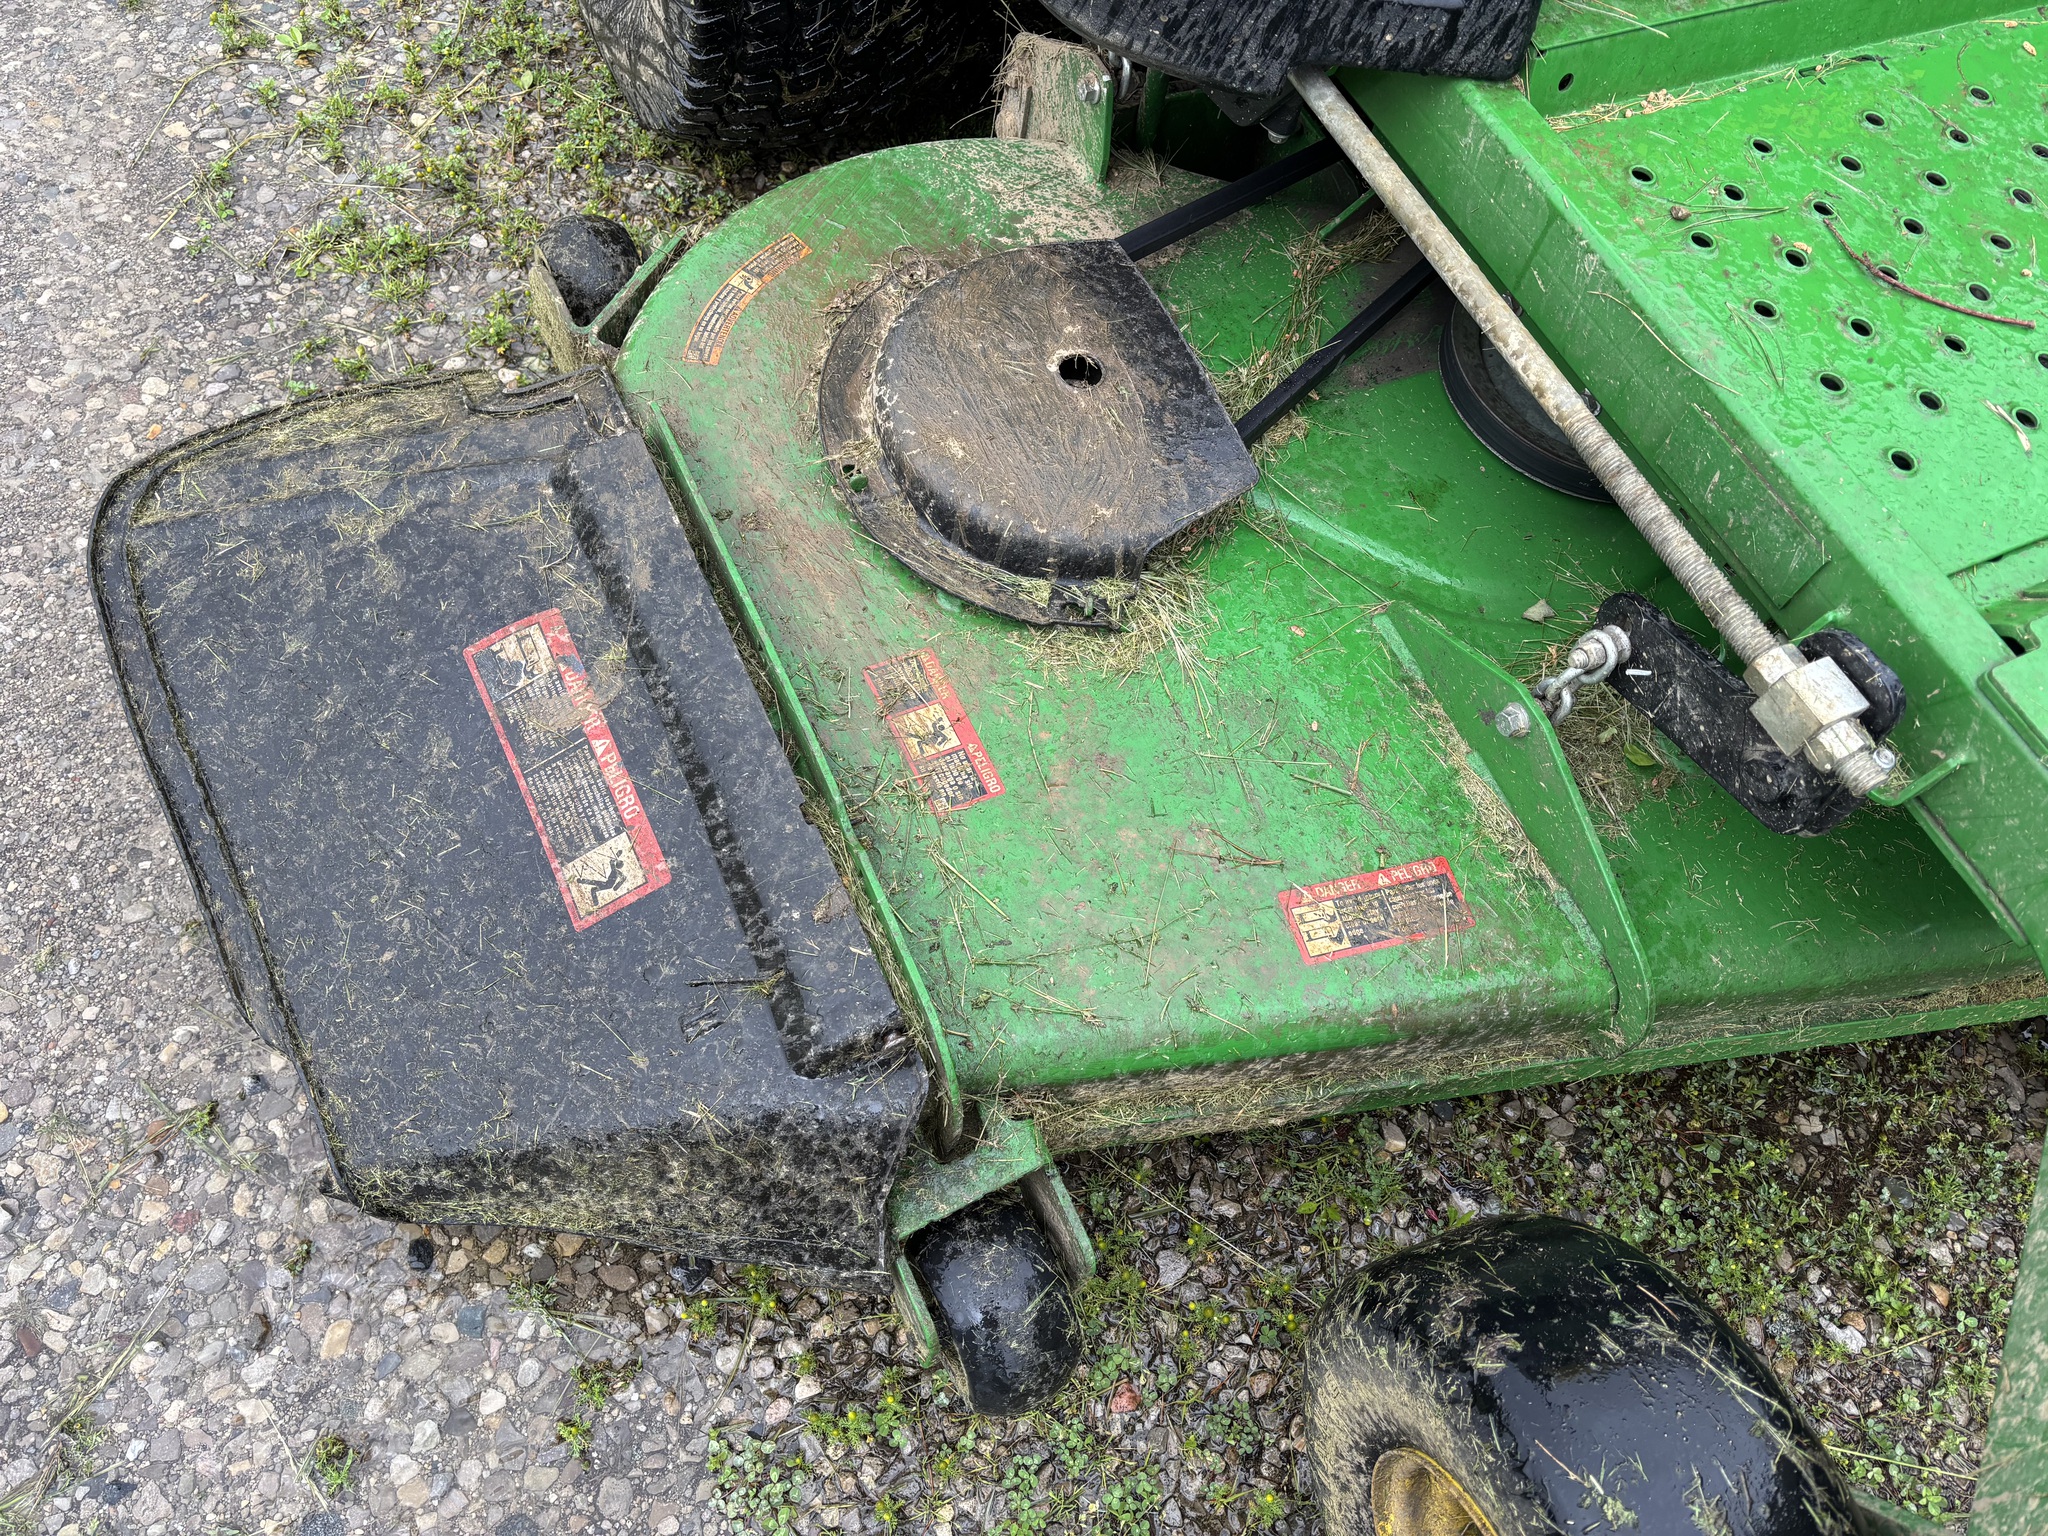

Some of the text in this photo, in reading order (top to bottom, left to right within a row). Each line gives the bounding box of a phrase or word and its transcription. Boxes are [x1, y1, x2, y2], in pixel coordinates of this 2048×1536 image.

[563, 666, 603, 731] DANR
[924, 660, 951, 699] DANER
[599, 751, 641, 821] PELIGRO
[961, 759, 974, 774] uar
[971, 750, 1001, 794] PELIGRO
[1389, 861, 1438, 881] PELGRO
